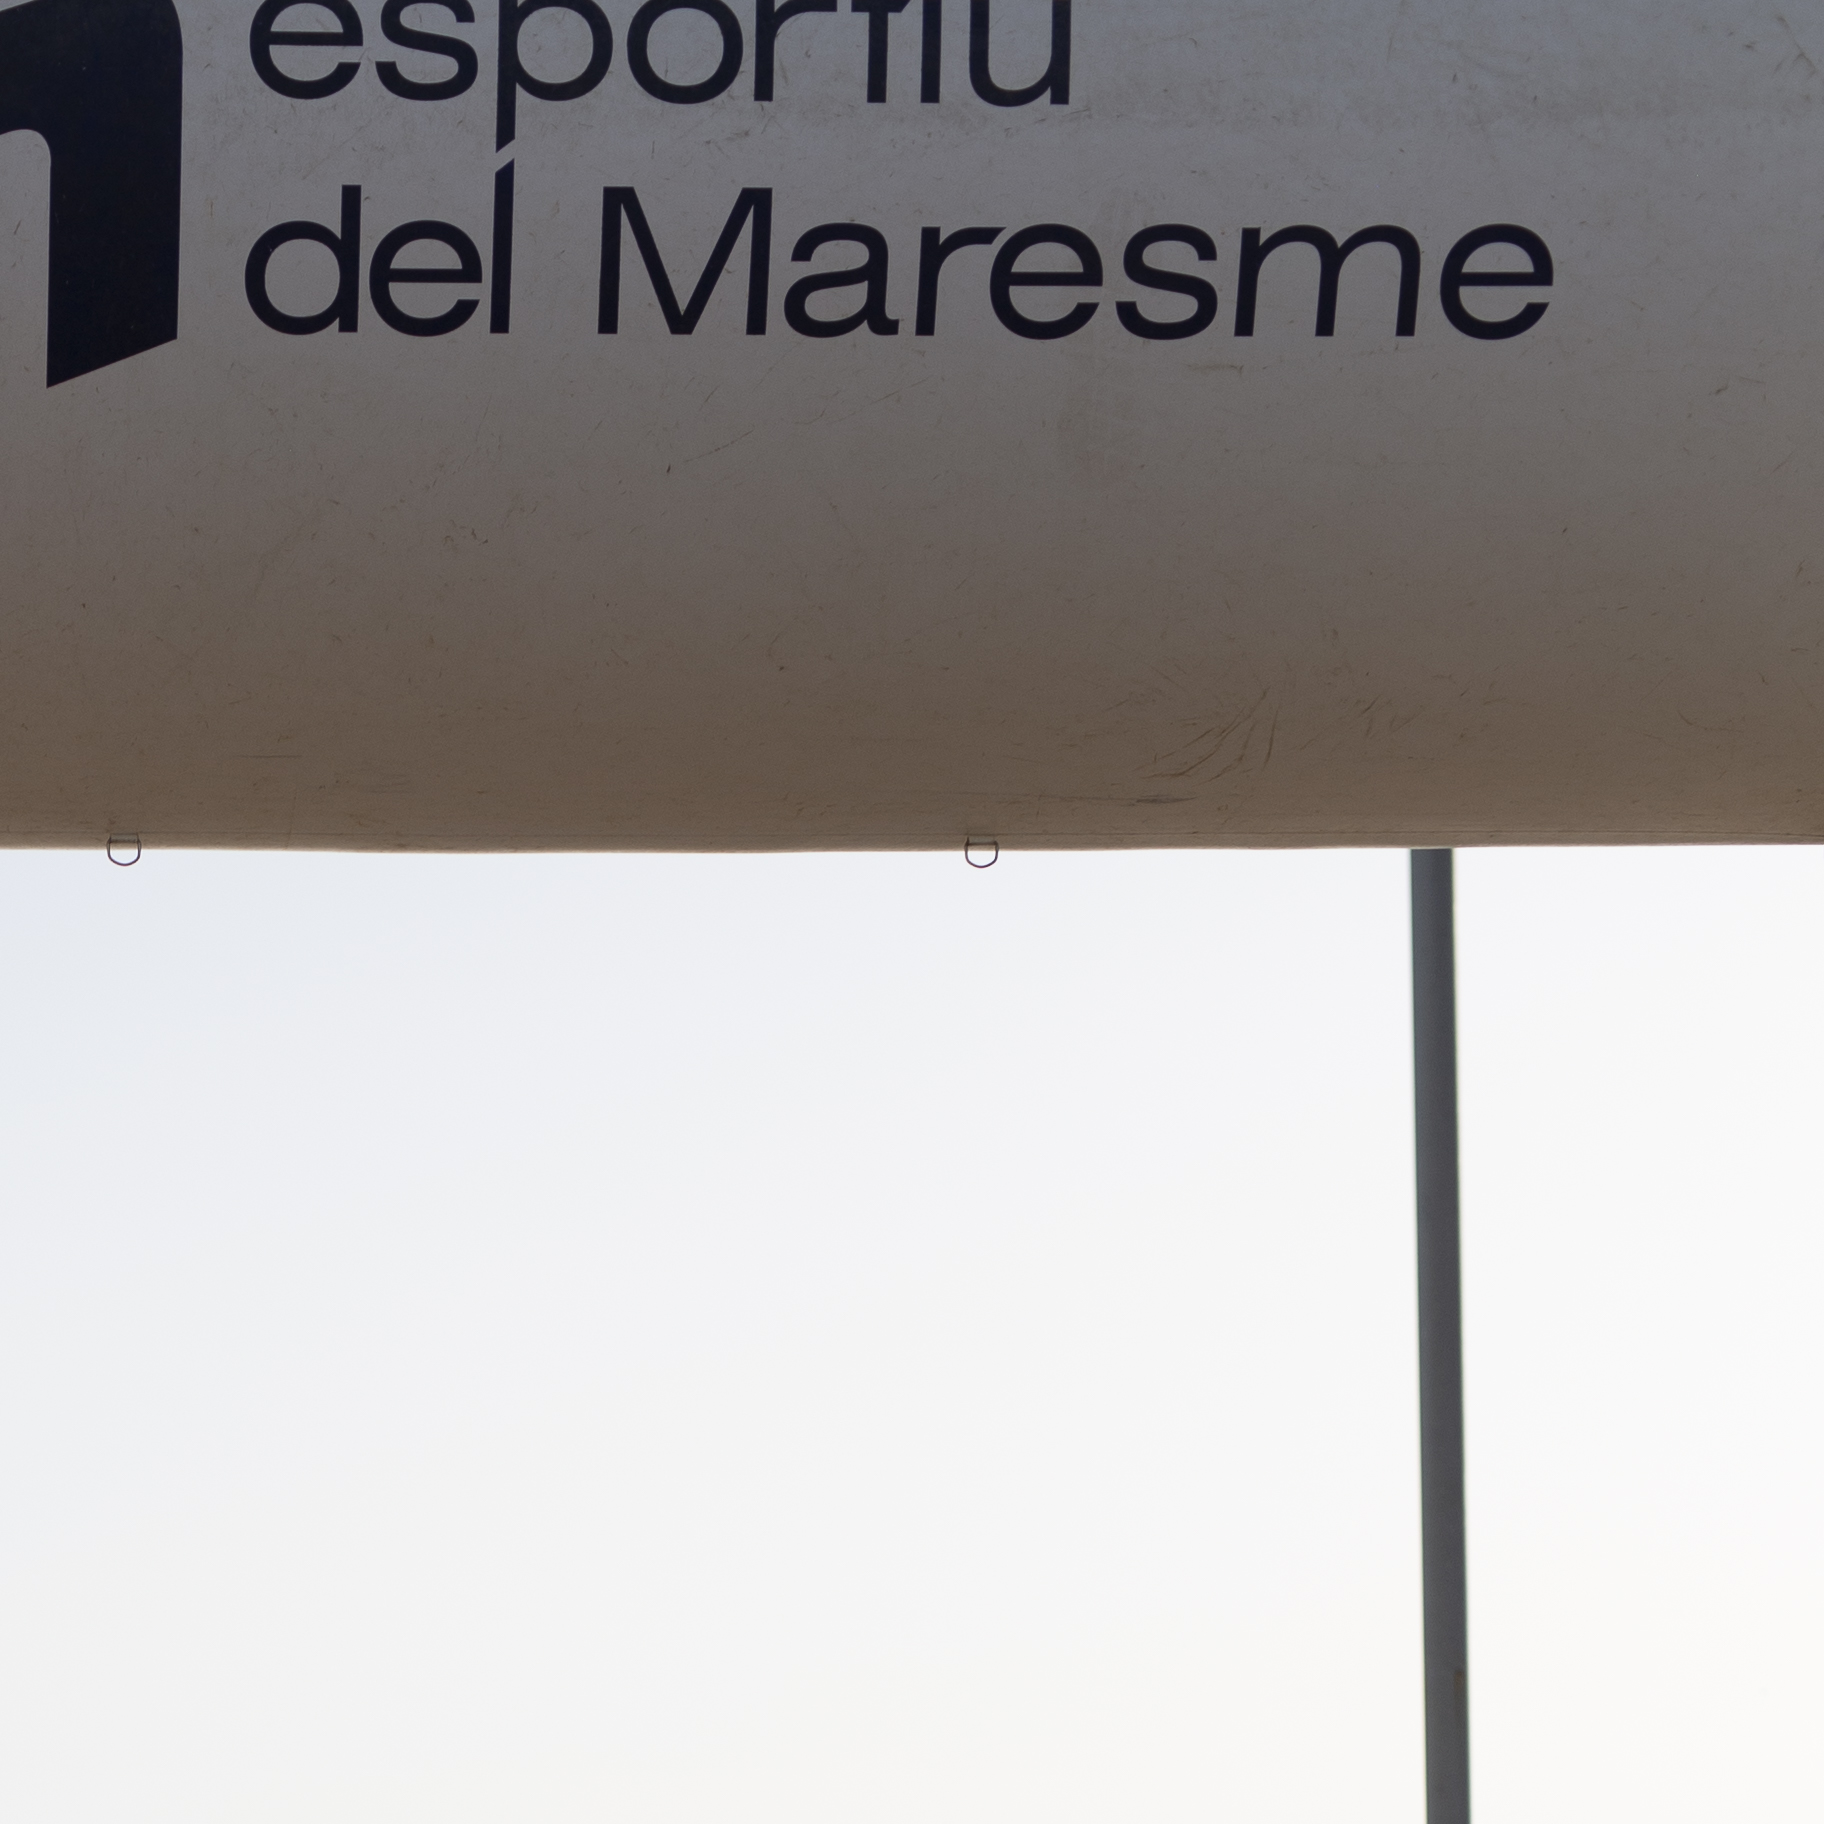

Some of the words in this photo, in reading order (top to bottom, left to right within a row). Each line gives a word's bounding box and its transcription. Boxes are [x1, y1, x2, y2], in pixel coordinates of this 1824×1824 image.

[248, 0, 1071, 152] esportiu
[243, 158, 516, 336] del
[597, 185, 1554, 341] Maresme
